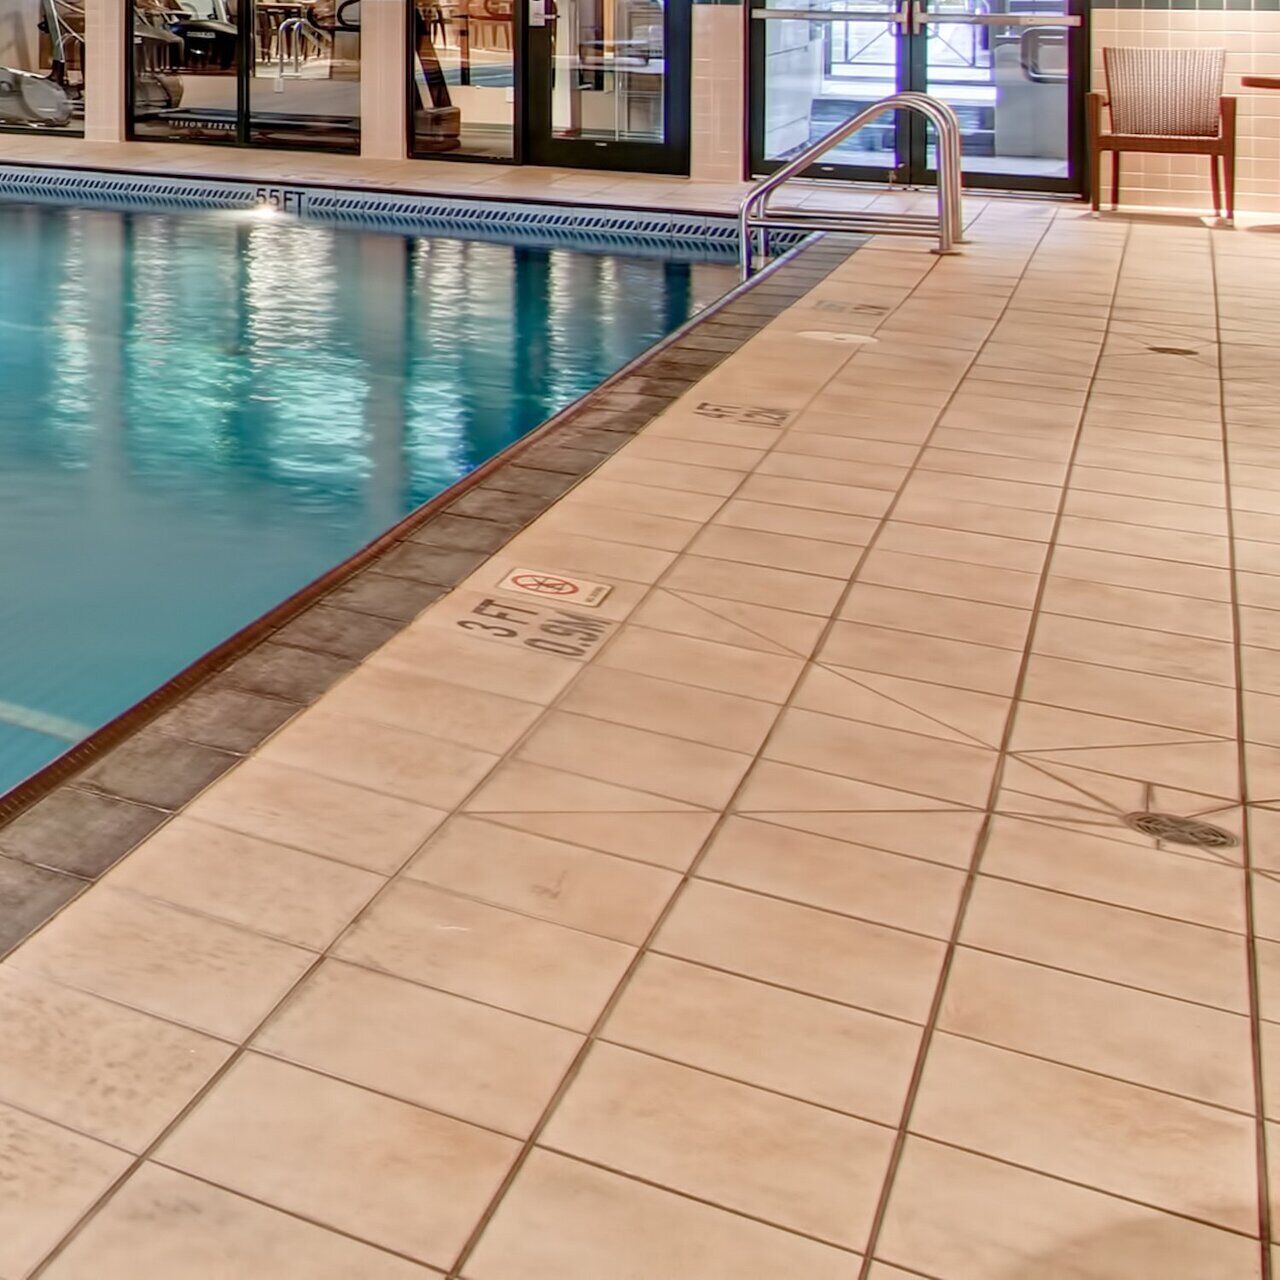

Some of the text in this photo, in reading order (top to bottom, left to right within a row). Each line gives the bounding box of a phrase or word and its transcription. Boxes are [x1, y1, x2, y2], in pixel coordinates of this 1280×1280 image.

[207, 122, 237, 130] FITNE
[457, 598, 539, 638] 3 FT
